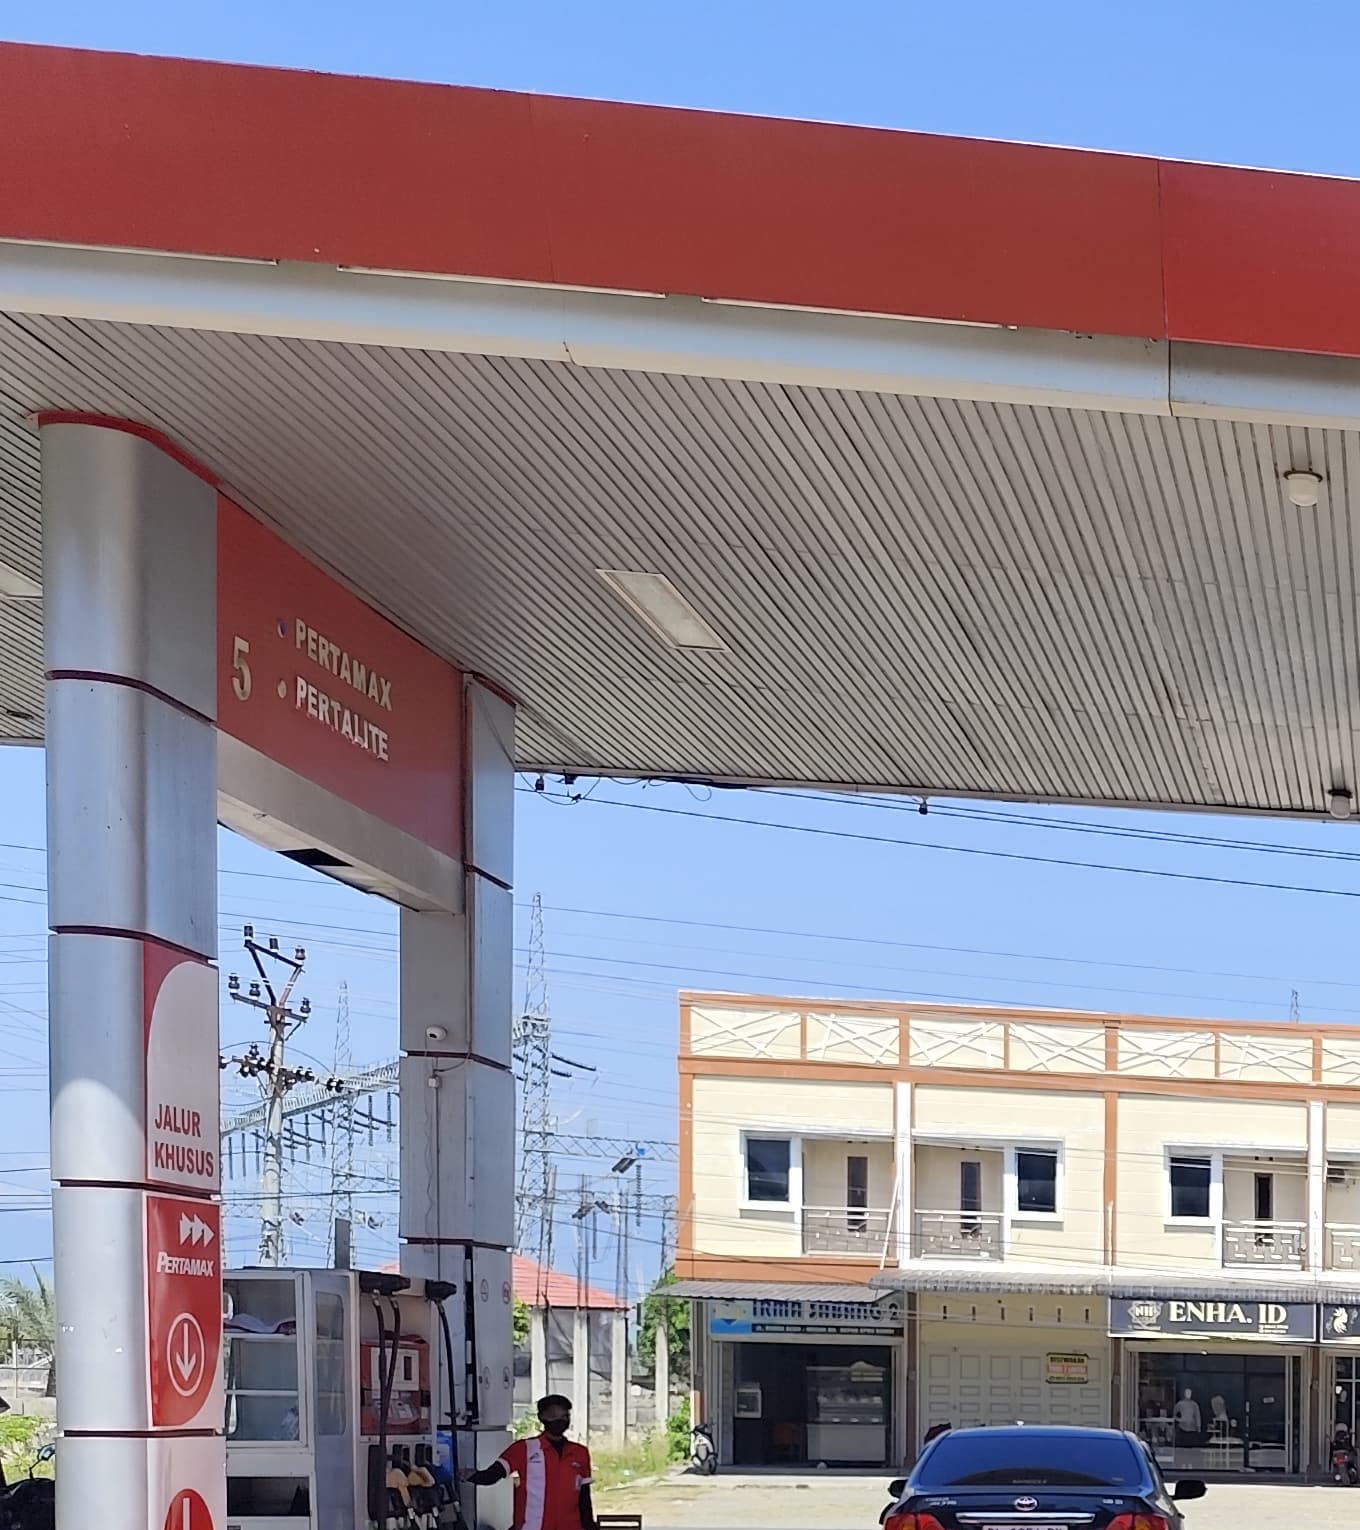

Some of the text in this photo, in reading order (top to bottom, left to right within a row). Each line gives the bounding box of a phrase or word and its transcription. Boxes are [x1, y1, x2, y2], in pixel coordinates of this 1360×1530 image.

[232, 636, 253, 701] 5
[295, 618, 393, 712] PERTAMAX
[295, 676, 390, 761] PERTALITE
[154, 1103, 202, 1138] JALUR
[154, 1141, 214, 1178] KHUSUS
[156, 1251, 214, 1278] PERTAMAX
[1258, 1303, 1288, 1325] ID
